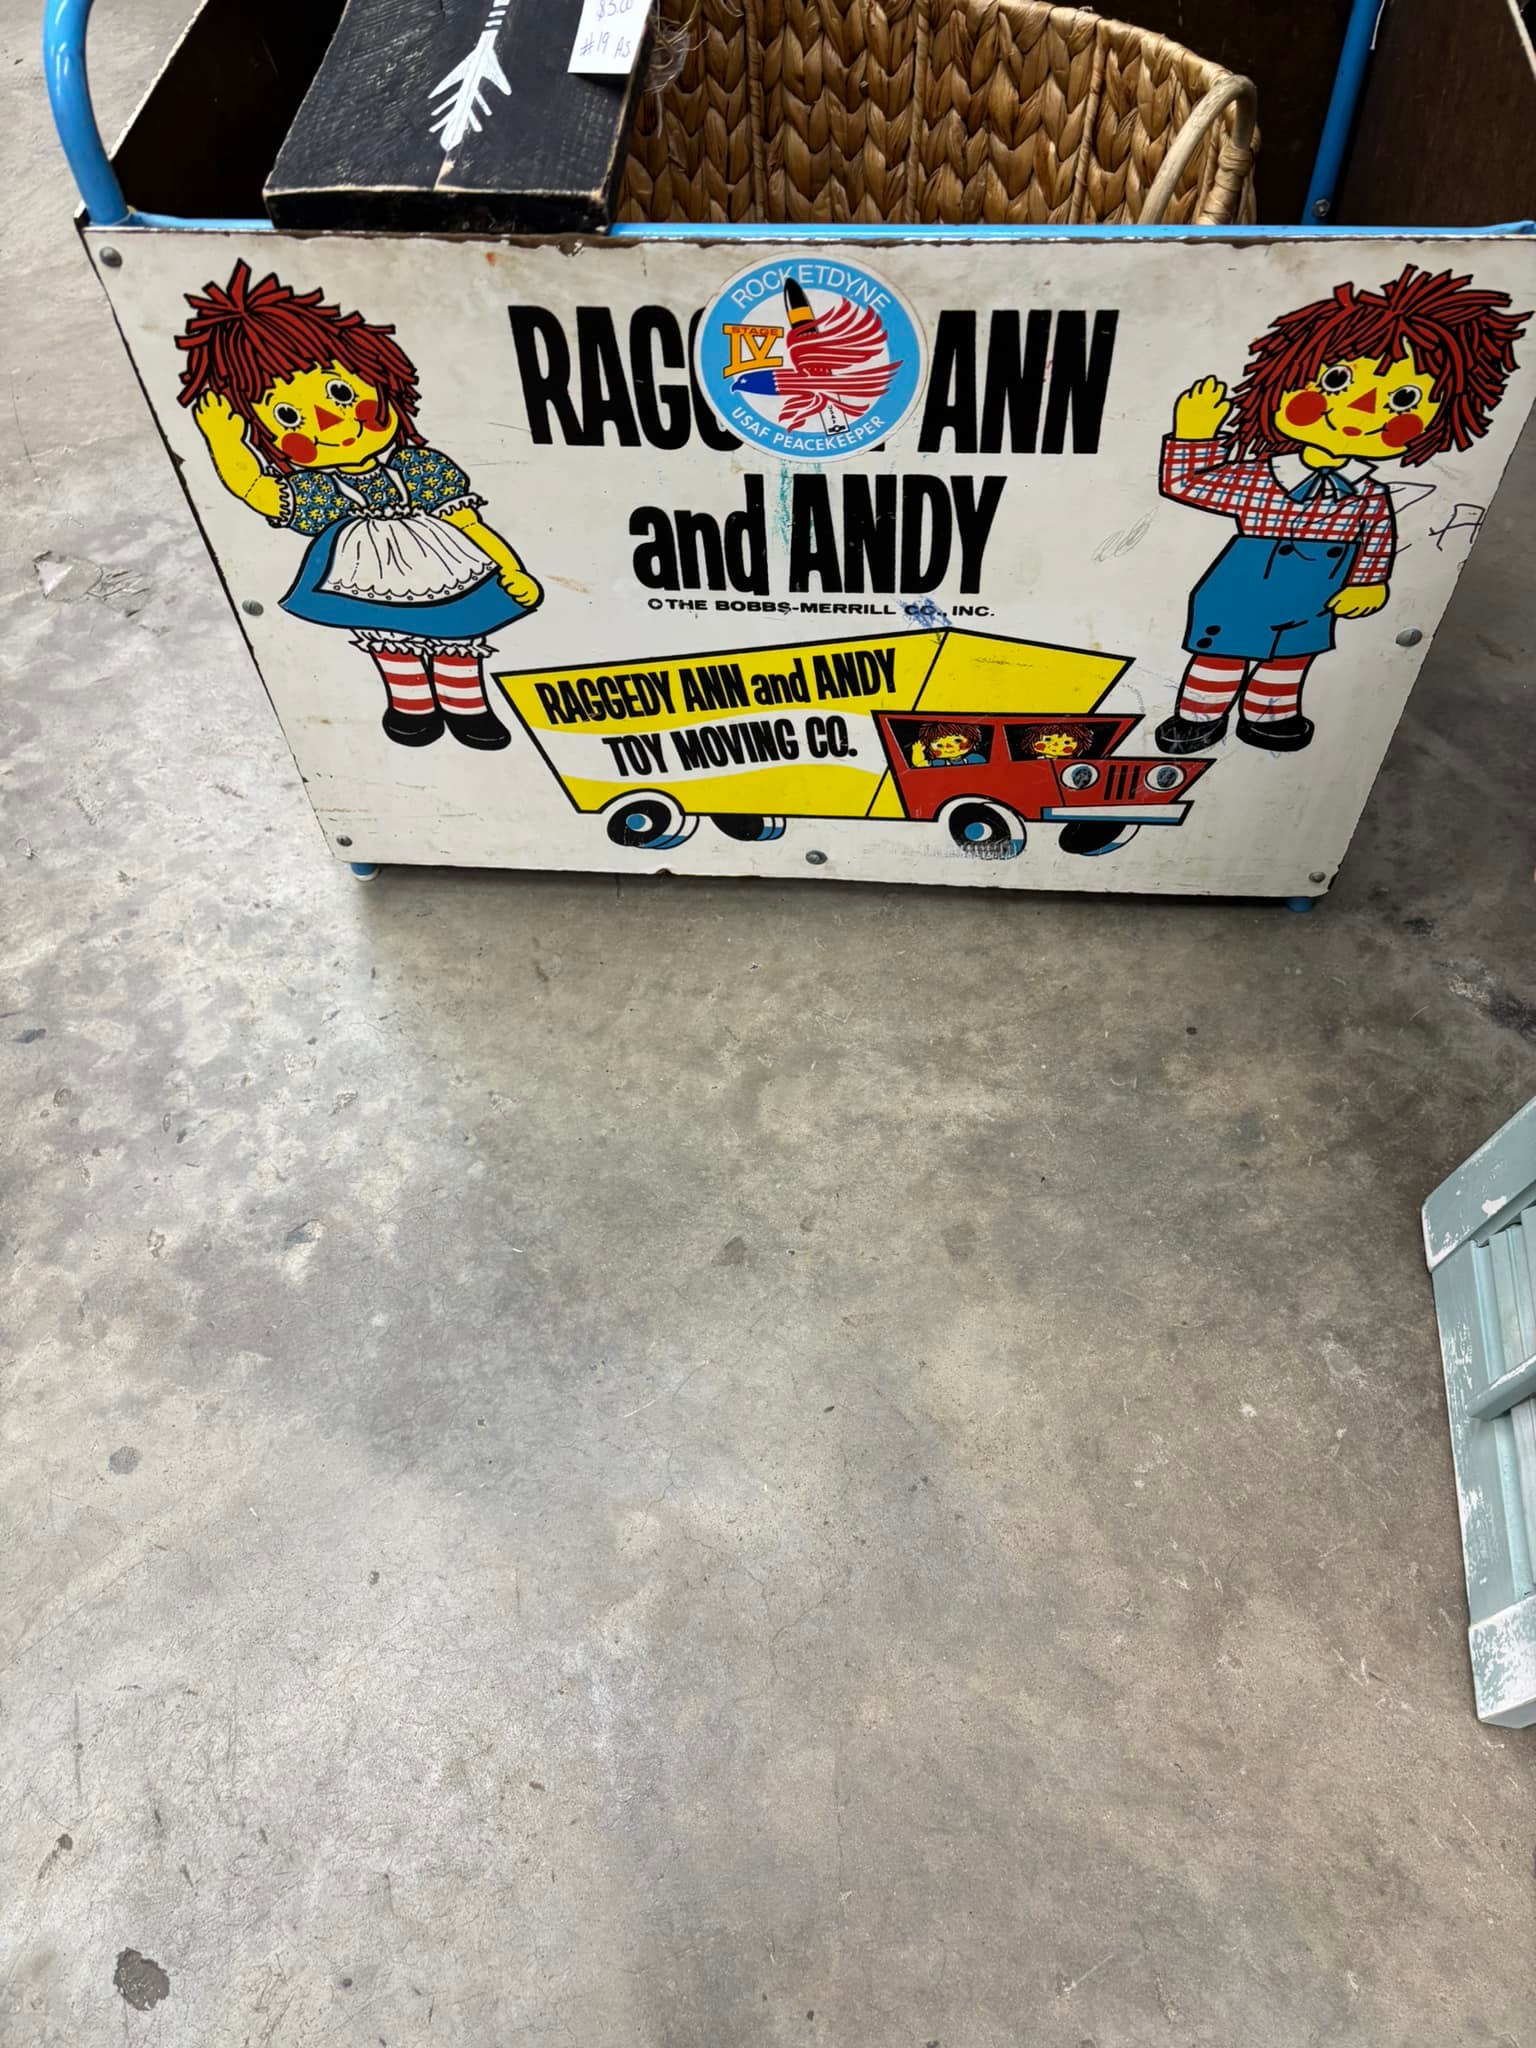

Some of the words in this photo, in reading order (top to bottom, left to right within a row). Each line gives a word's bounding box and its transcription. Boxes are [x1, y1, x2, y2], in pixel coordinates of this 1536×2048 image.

[731, 264, 891, 313] ROCKETDYNE
[723, 323, 784, 379] IV
[731, 327, 779, 336] STAGE
[918, 310, 1119, 454] ANN
[731, 406, 770, 438] USAF
[772, 414, 886, 452] PEACEKEEPER
[629, 474, 769, 596] and
[789, 474, 1007, 594] ANDY
[715, 600, 897, 616] BOBBS-MERRILL
[952, 605, 995, 617] INC.
[535, 670, 676, 725] RAGGEDY
[678, 663, 750, 713] ANN
[750, 658, 812, 707] and
[812, 648, 896, 701] ANDY
[602, 733, 669, 777] TOY
[670, 719, 800, 771] MOVING
[805, 715, 858, 759] CO.
